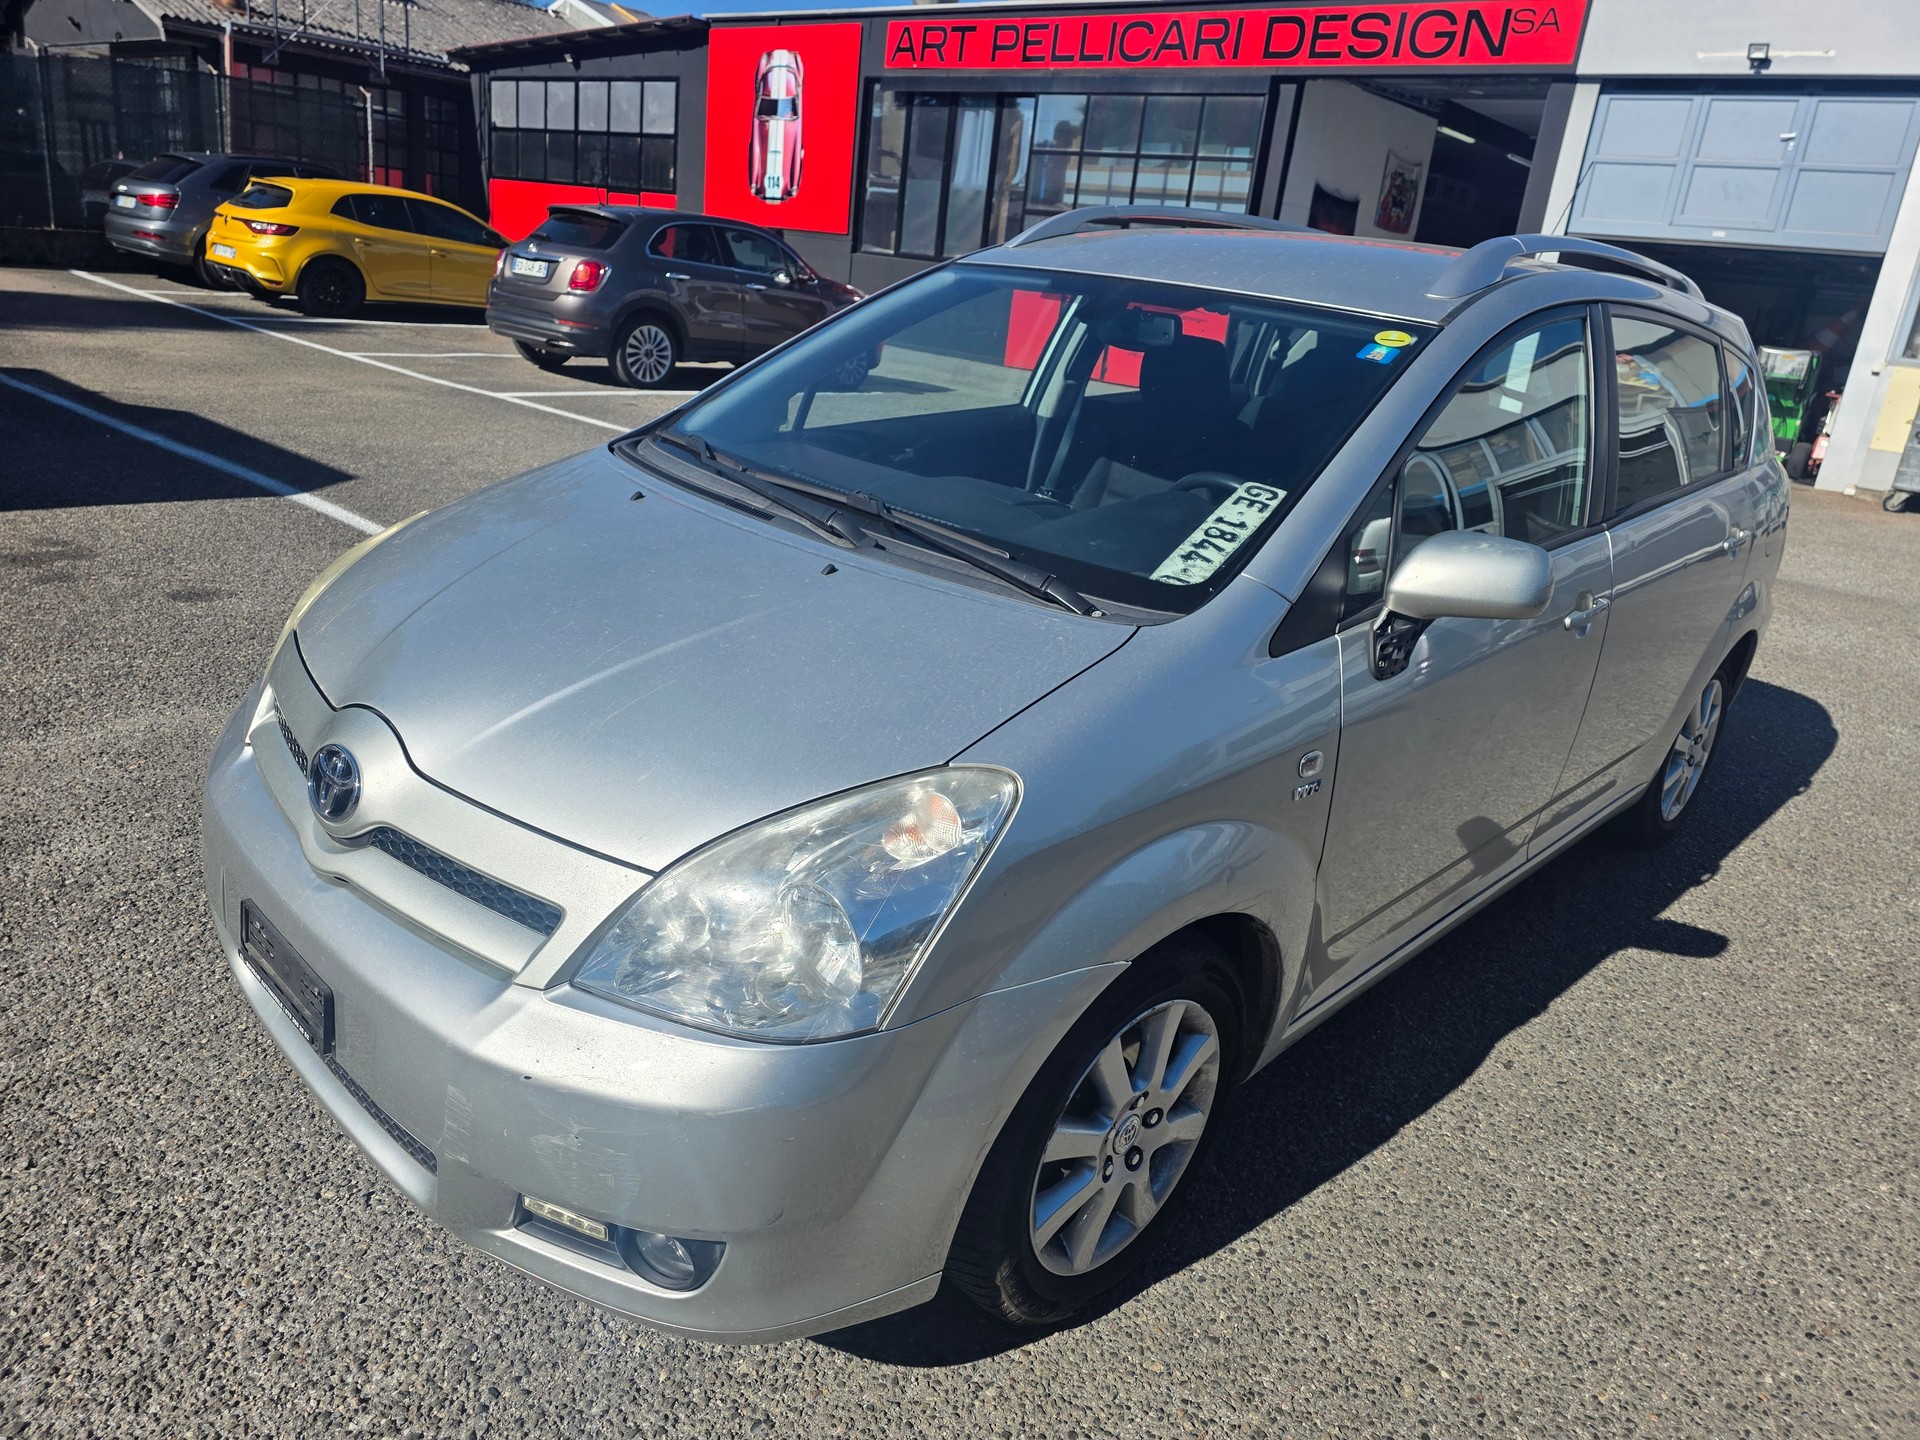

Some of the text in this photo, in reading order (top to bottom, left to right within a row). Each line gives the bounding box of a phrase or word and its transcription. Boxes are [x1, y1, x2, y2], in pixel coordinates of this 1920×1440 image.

[890, 7, 1560, 62] ART PELLICARI DESIGN SA
[766, 175, 780, 189] 114
